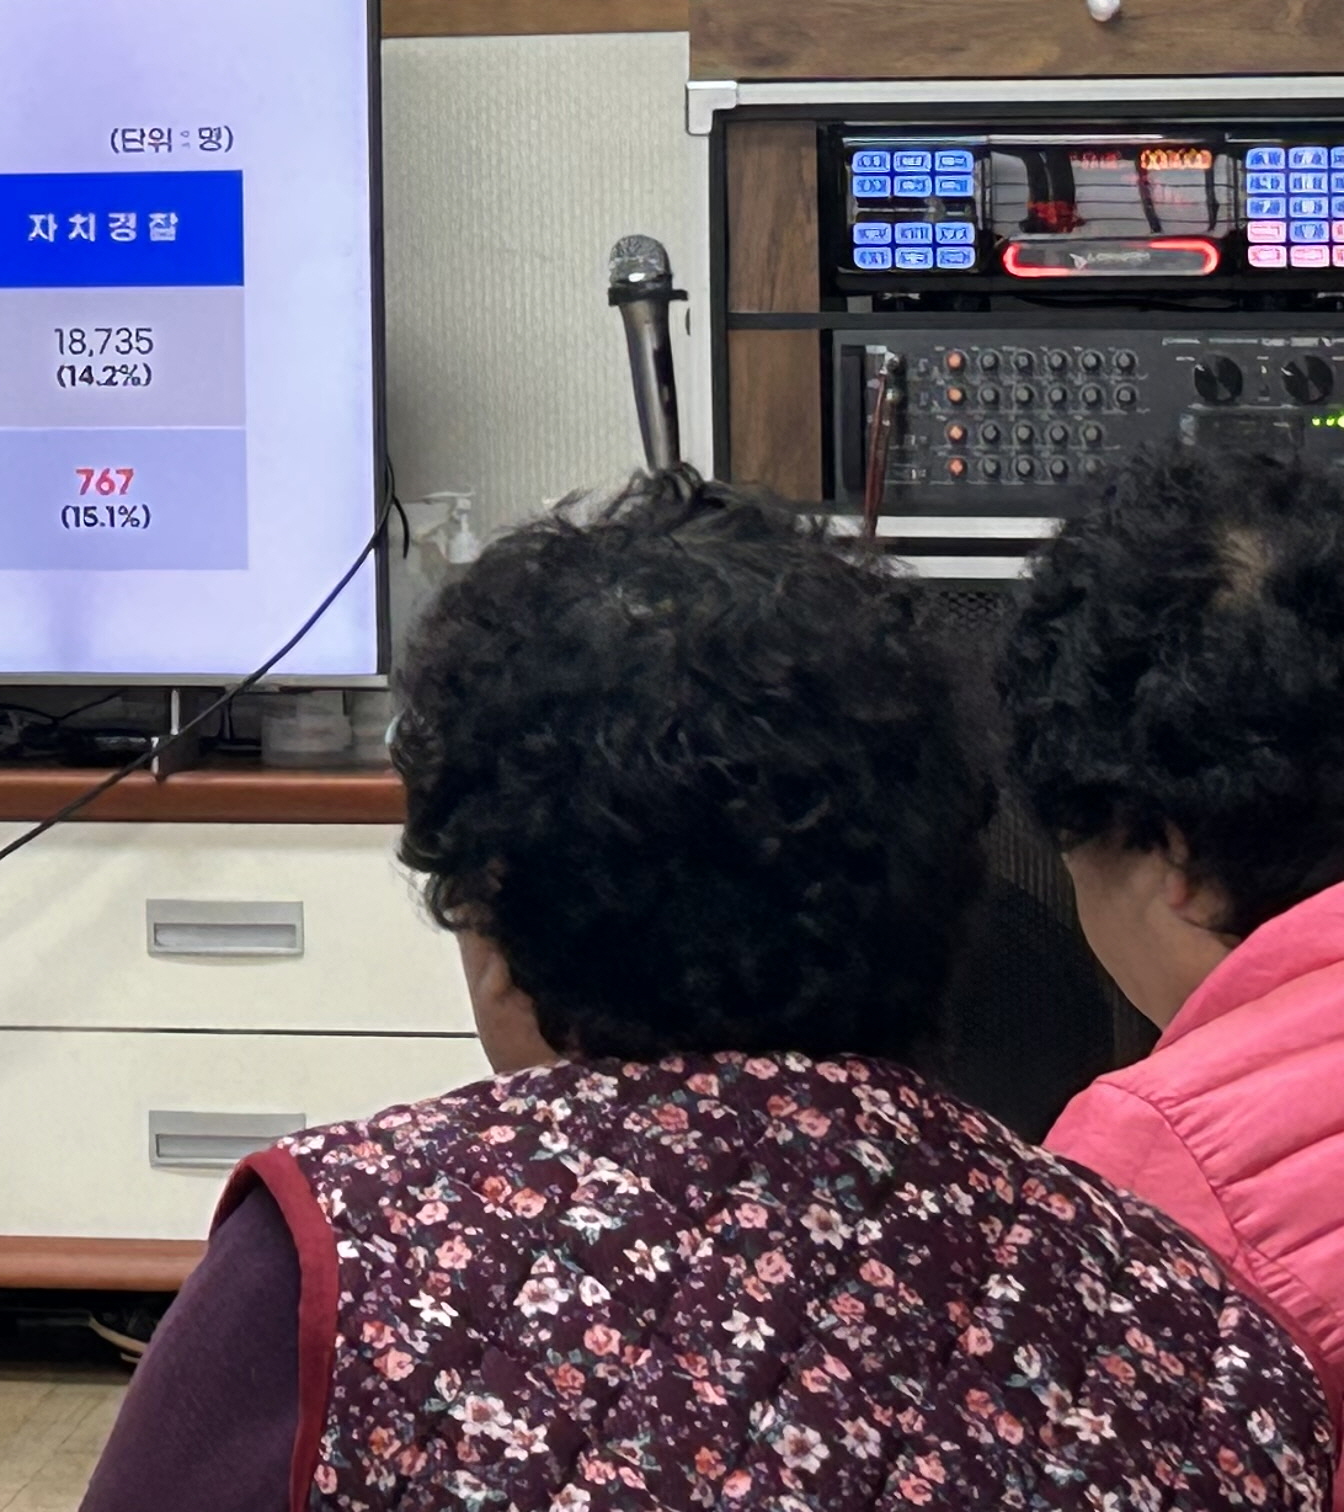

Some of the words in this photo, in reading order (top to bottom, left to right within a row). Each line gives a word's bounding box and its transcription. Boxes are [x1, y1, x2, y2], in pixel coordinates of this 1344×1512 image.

[110, 126, 173, 155] (단위
[53, 327, 154, 358] 18,735
[56, 362, 153, 389] (14.2%)
[75, 467, 136, 497] 767
[60, 504, 153, 531] (15.1%)
